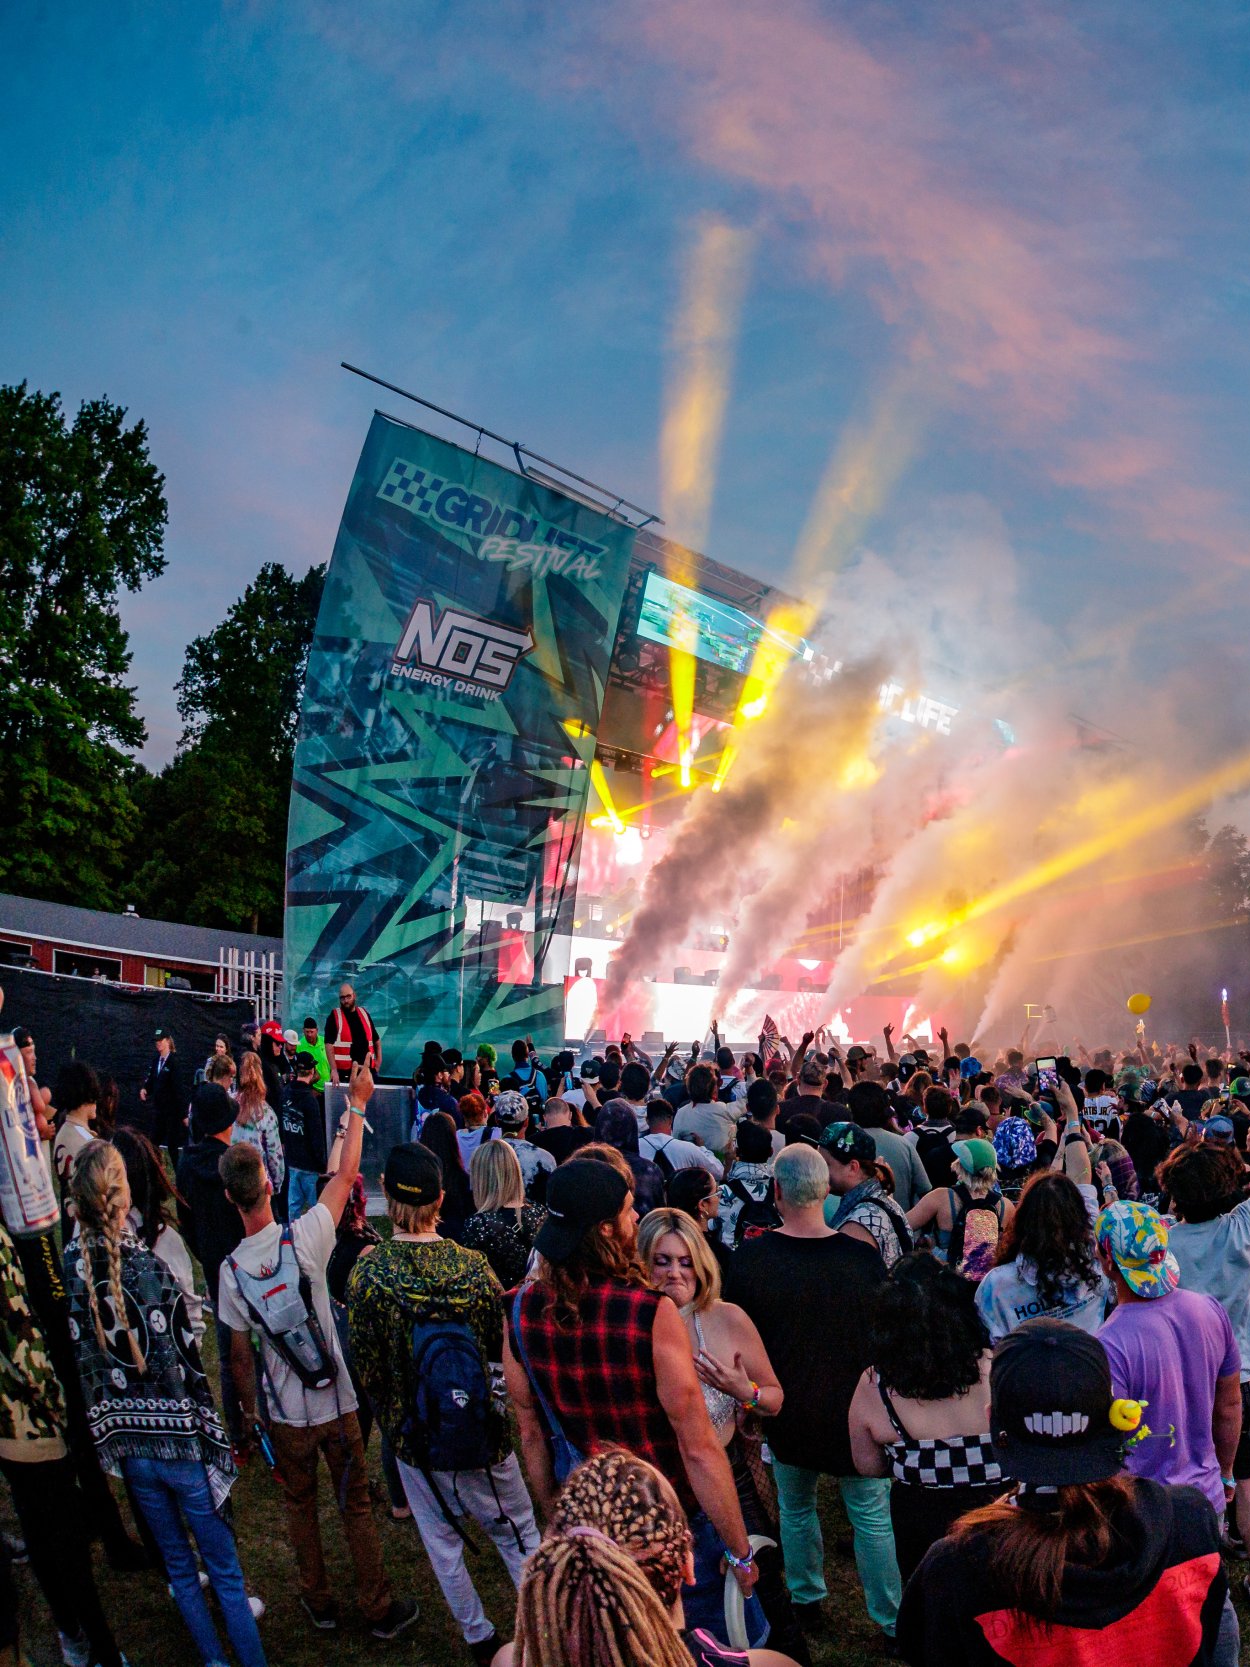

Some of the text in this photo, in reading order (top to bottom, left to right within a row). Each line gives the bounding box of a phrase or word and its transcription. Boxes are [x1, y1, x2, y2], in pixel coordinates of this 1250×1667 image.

[393, 598, 537, 688] NOS
[390, 663, 503, 702] ENERGY DRINK
